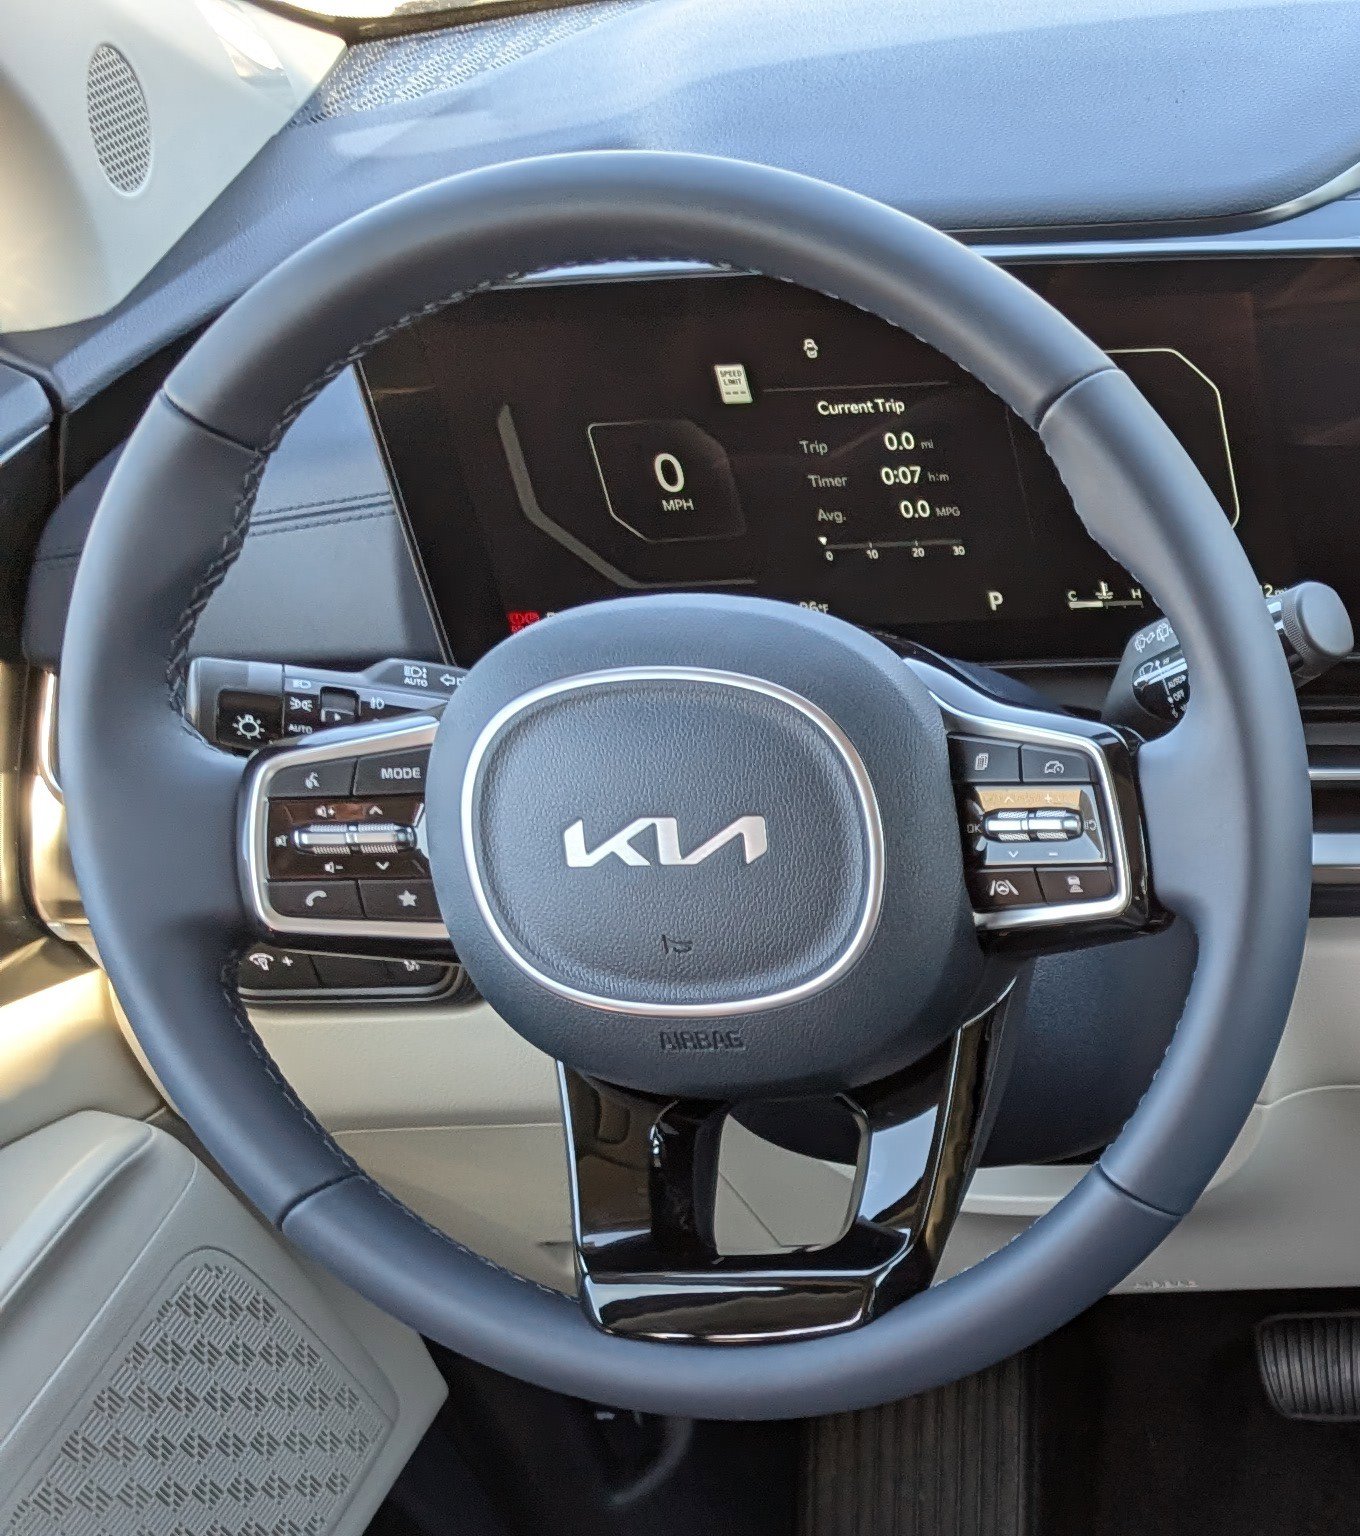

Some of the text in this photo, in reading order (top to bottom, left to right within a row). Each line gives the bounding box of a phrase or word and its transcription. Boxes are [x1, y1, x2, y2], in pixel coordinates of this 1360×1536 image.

[817, 398, 905, 415] Current Trip
[799, 431, 933, 455] Trip 0.0 mi
[654, 453, 685, 492] 0
[808, 466, 949, 487] Timer 0:07 h:m
[662, 499, 694, 512] MPH
[817, 500, 960, 523] Avg. 0.0 MPG
[825, 545, 965, 561] 0 10 20 30
[988, 591, 1003, 611] P
[1067, 590, 1078, 601] C
[1132, 588, 1142, 599] H
[404, 677, 428, 687] AUTO
[288, 722, 313, 734] AUTO
[381, 766, 422, 780] MODE
[967, 824, 981, 834] OK
[564, 816, 767, 867] KIA
[660, 1030, 745, 1051] AIRBAG
